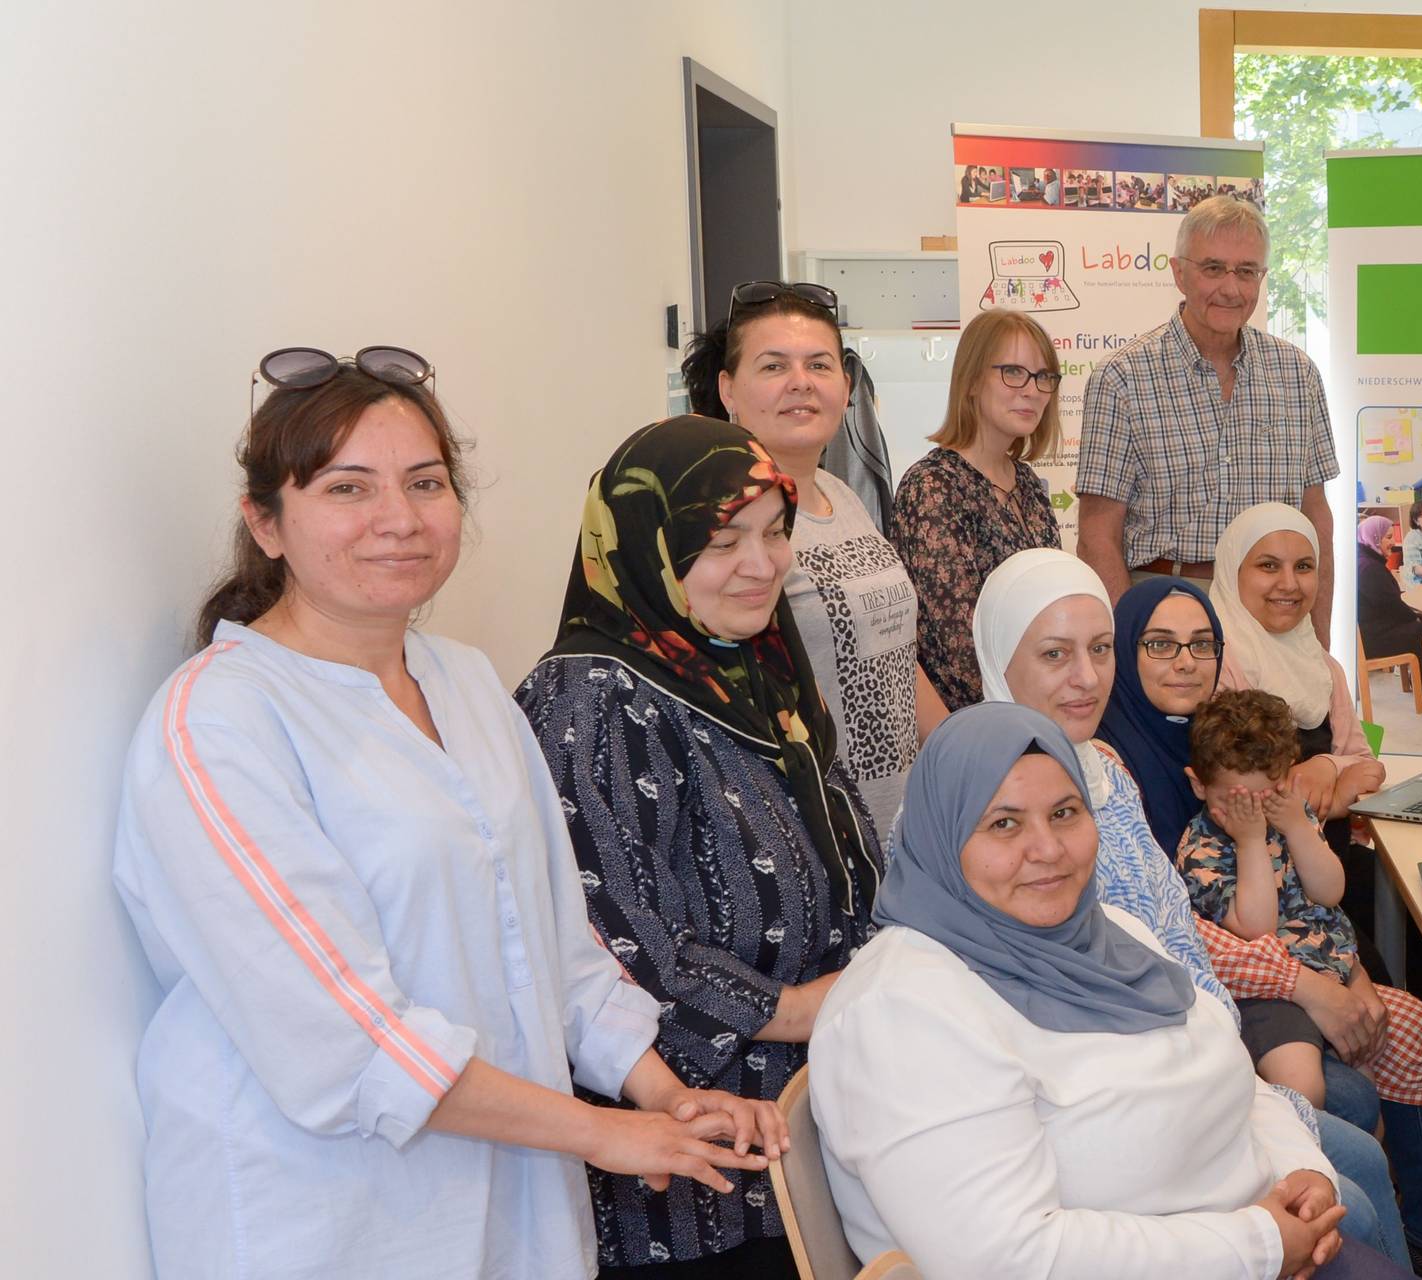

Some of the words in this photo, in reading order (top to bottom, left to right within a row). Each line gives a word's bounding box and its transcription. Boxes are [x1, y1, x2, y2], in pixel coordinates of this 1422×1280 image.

[1001, 255, 1035, 266] Labdoo
[1082, 242, 1169, 271] Labdo
[1053, 338, 1072, 349] en
[1076, 333, 1099, 349] für
[1058, 394, 1084, 405] tops,
[886, 581, 912, 607] JOLIE
